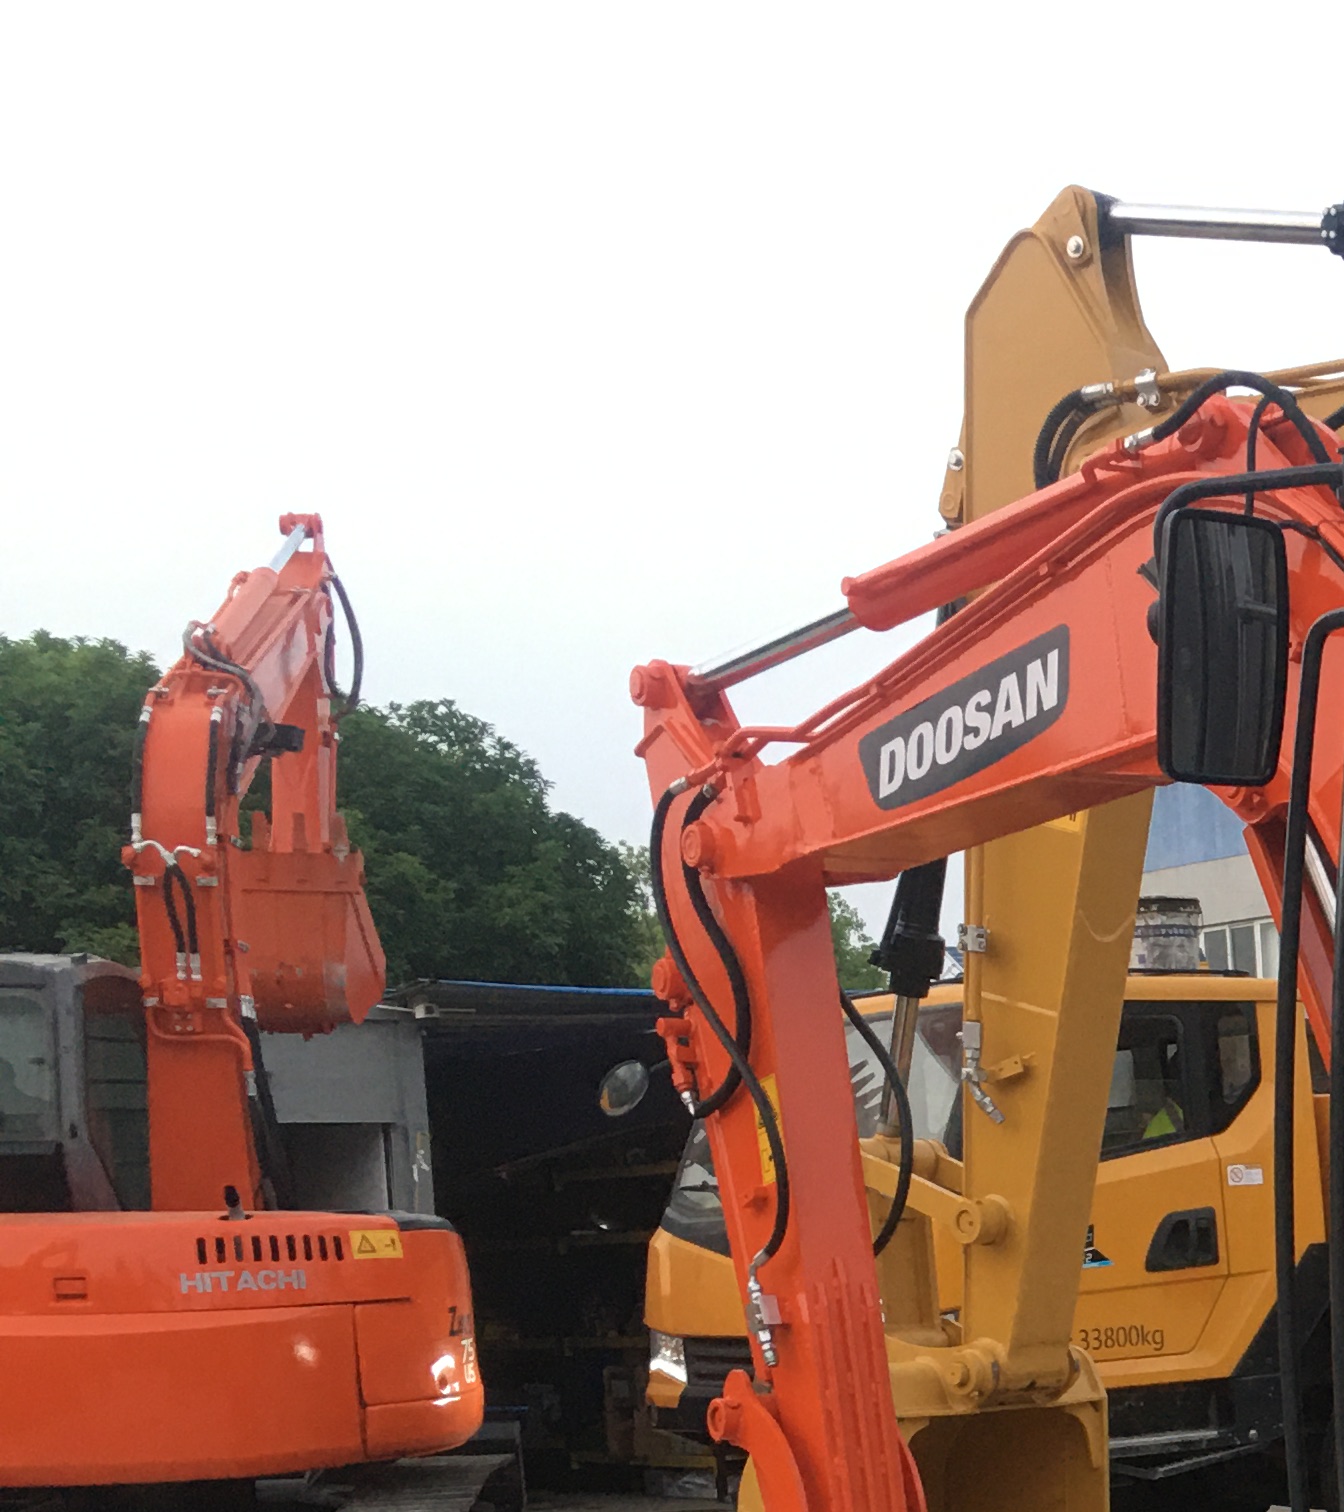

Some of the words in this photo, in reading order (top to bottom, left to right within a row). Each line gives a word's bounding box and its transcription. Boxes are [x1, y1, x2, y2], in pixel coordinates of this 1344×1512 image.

[878, 648, 1059, 799] DOOSAN
[179, 1269, 307, 1294] HITACHI
[1078, 1325, 1164, 1351] 33800kg
